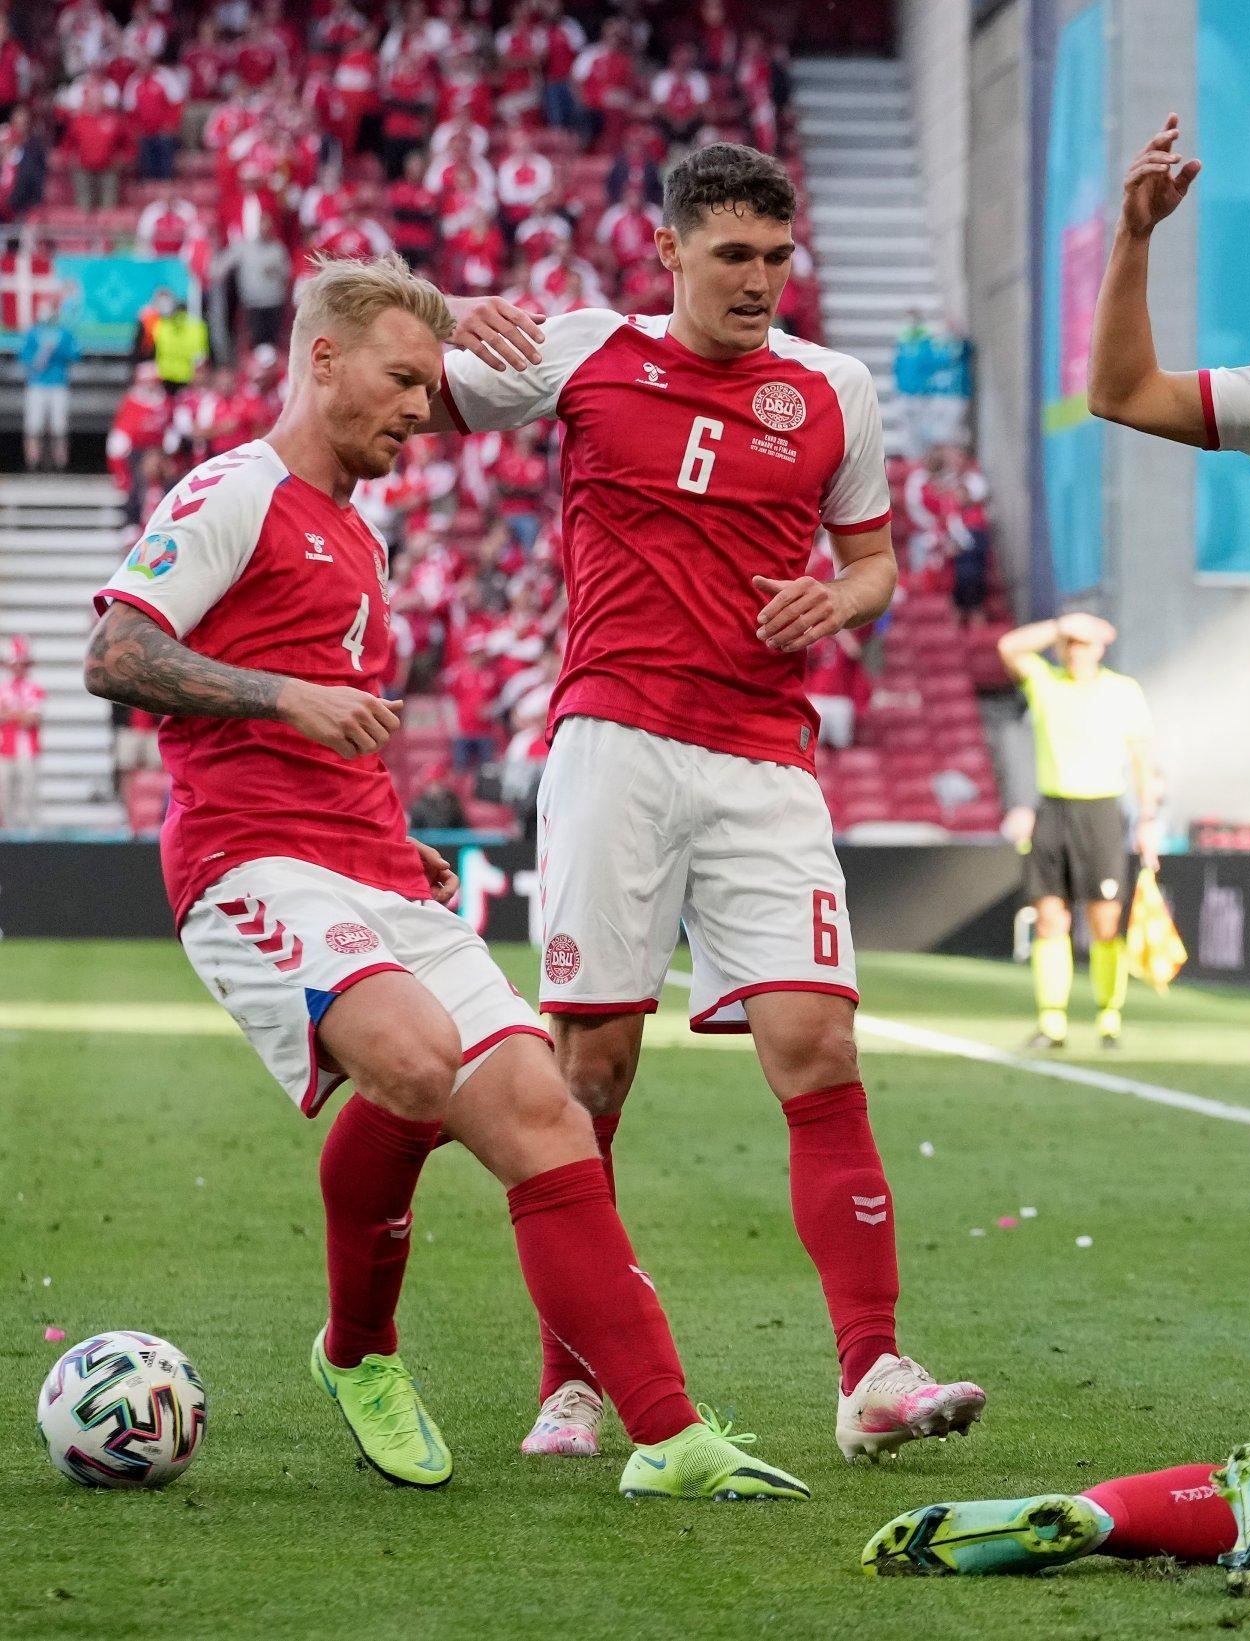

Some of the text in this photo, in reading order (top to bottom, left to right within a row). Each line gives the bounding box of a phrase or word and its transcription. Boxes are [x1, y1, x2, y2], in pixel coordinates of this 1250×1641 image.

[764, 398, 794, 416] DBU
[677, 416, 724, 495] 6
[342, 592, 369, 672] 4
[335, 931, 369, 945] DBU
[813, 889, 838, 967] 6
[552, 951, 573, 967] DBU
